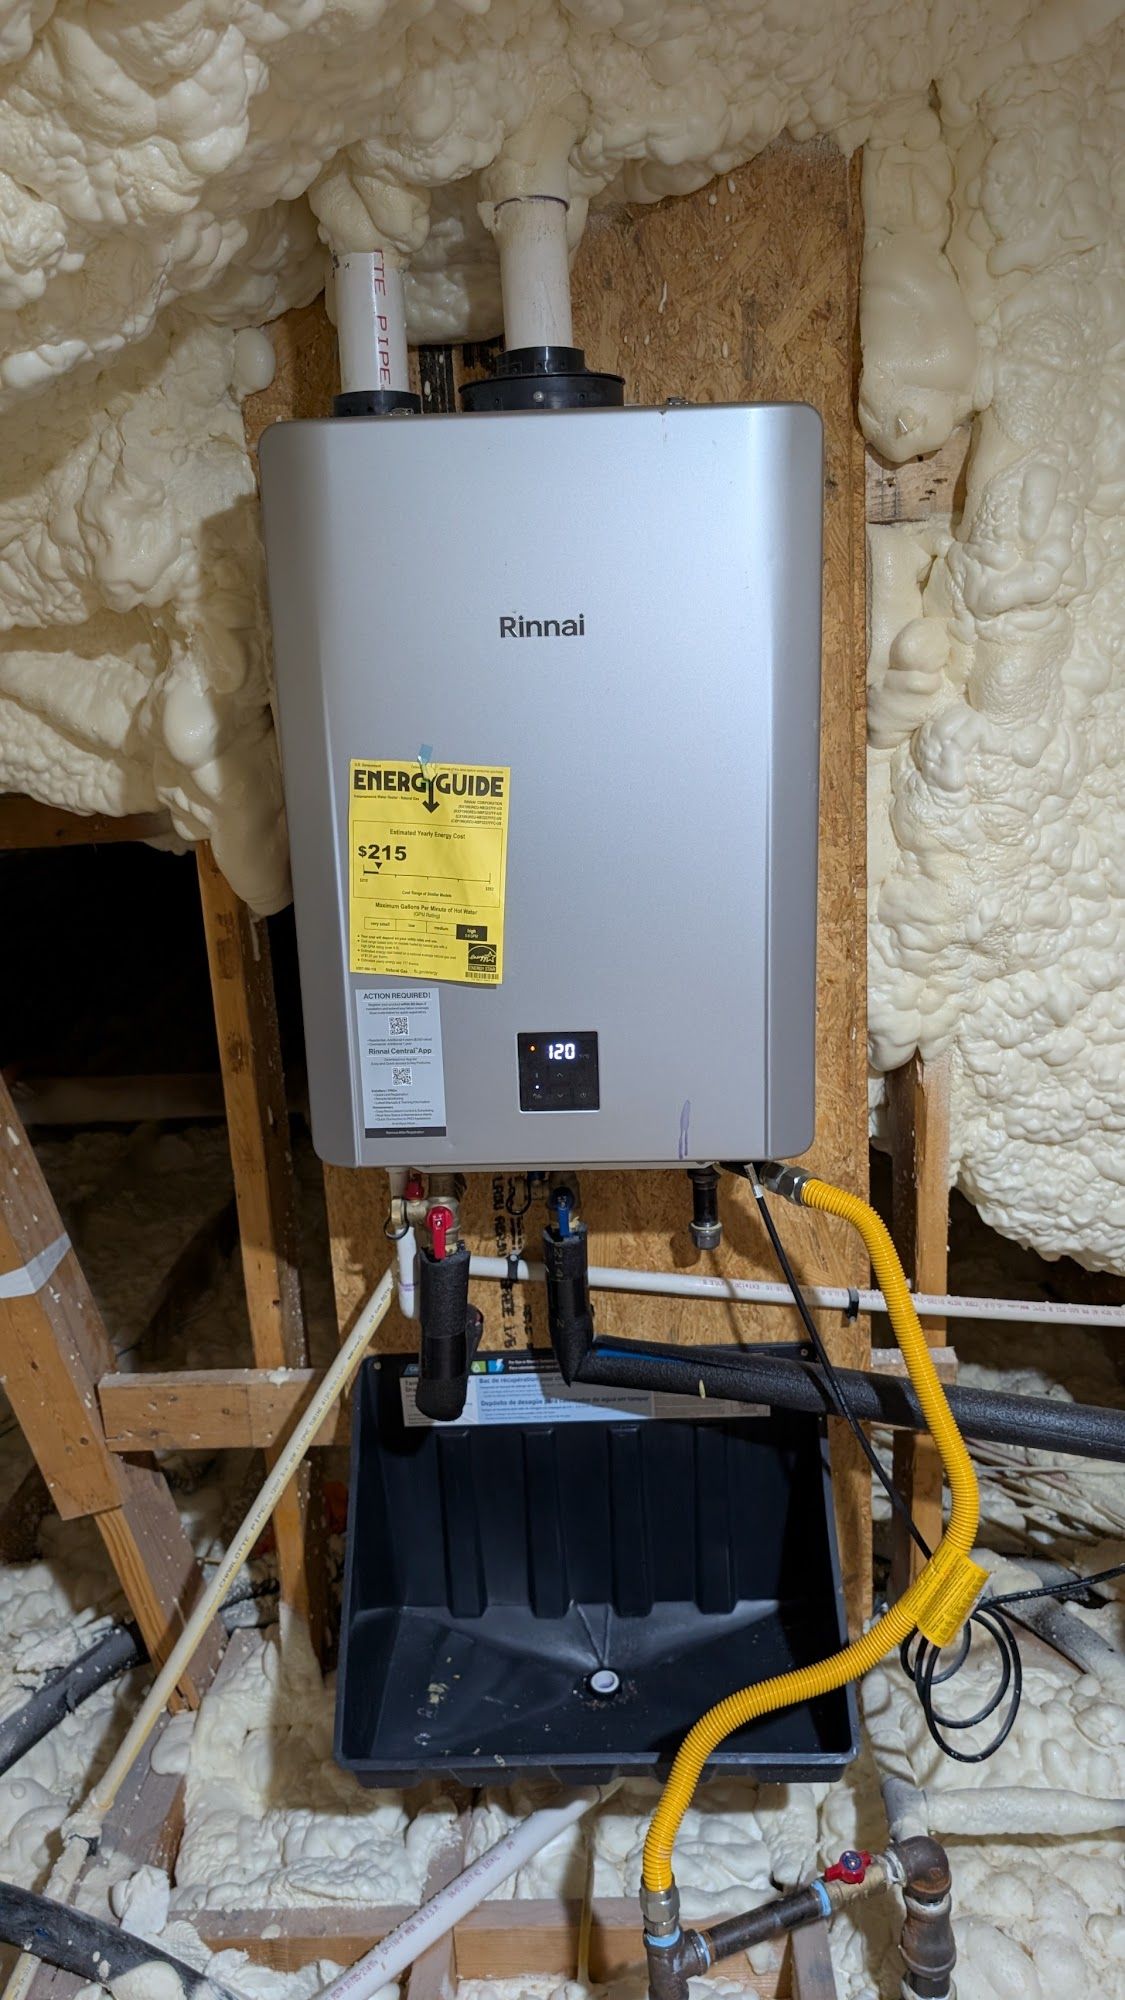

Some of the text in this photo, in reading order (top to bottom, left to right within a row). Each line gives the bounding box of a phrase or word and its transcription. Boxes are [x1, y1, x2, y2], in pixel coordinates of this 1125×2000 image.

[376, 315, 390, 385] PIPE
[500, 614, 585, 638] Rinnai
[434, 831, 452, 840] Energy
[358, 844, 407, 861] $215
[548, 1043, 576, 1060] 120
